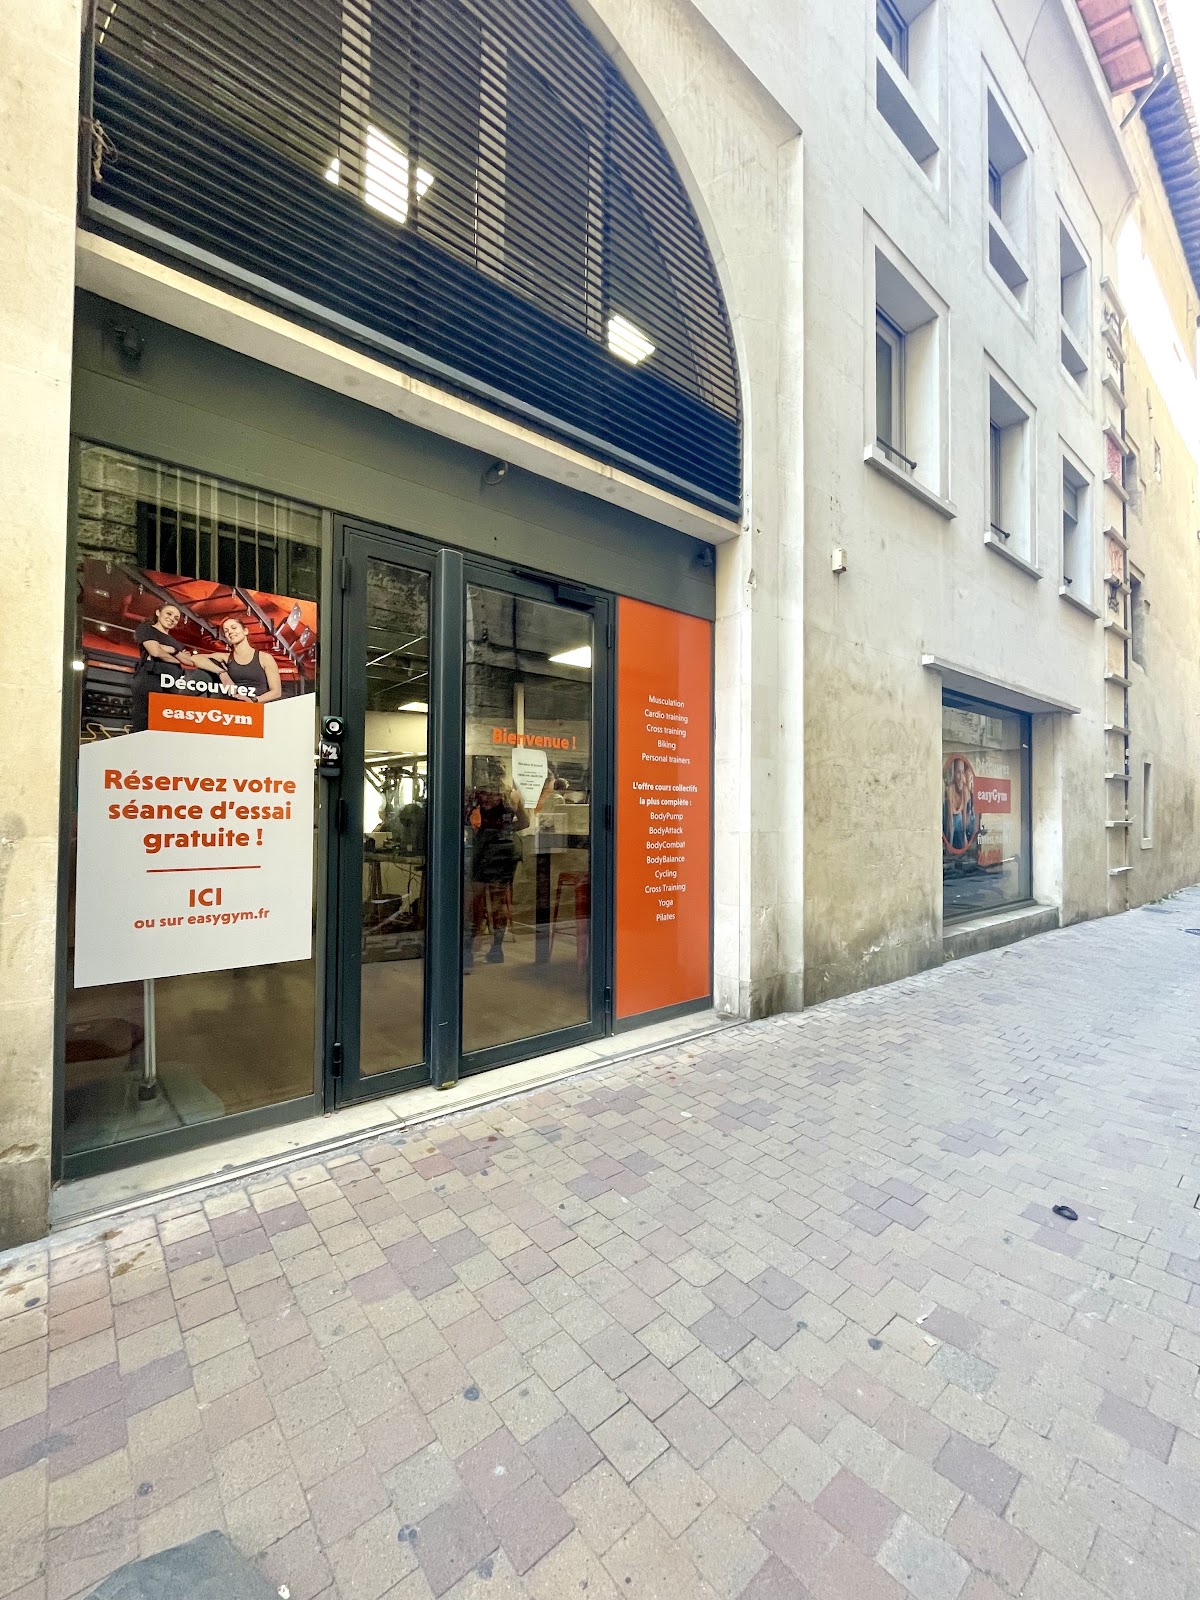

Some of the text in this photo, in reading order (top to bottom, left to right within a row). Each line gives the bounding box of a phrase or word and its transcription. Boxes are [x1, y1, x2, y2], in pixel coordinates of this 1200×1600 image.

[160, 674, 257, 697] Découvrez
[648, 695, 685, 708] Musculation
[162, 707, 252, 726] easyGym
[644, 709, 688, 724] Cardio training
[646, 724, 686, 738] Cross training
[492, 728, 577, 750] Bienvenue !
[657, 739, 676, 751] Biking
[641, 752, 691, 765] Personal trainers
[104, 769, 297, 795] Réservez votre
[632, 782, 698, 793] L'offre cours collectifs
[639, 796, 646, 805] la
[646, 797, 660, 807] plus
[660, 797, 689, 808] complète
[977, 788, 1008, 804] easyGym
[108, 800, 292, 820] séance d'essai
[650, 811, 684, 822] BodyPump
[648, 826, 684, 836] BodyAttack
[143, 827, 264, 854] gratuite !
[646, 841, 686, 851] BodyCombat
[646, 855, 686, 865] BodyBalance
[654, 869, 677, 880] Cycling
[644, 883, 686, 894] Cross Training
[188, 887, 222, 908] ICI
[657, 898, 674, 908] Yoga
[134, 908, 270, 929] ou sur easygym.fr
[656, 913, 676, 922] Pilates
